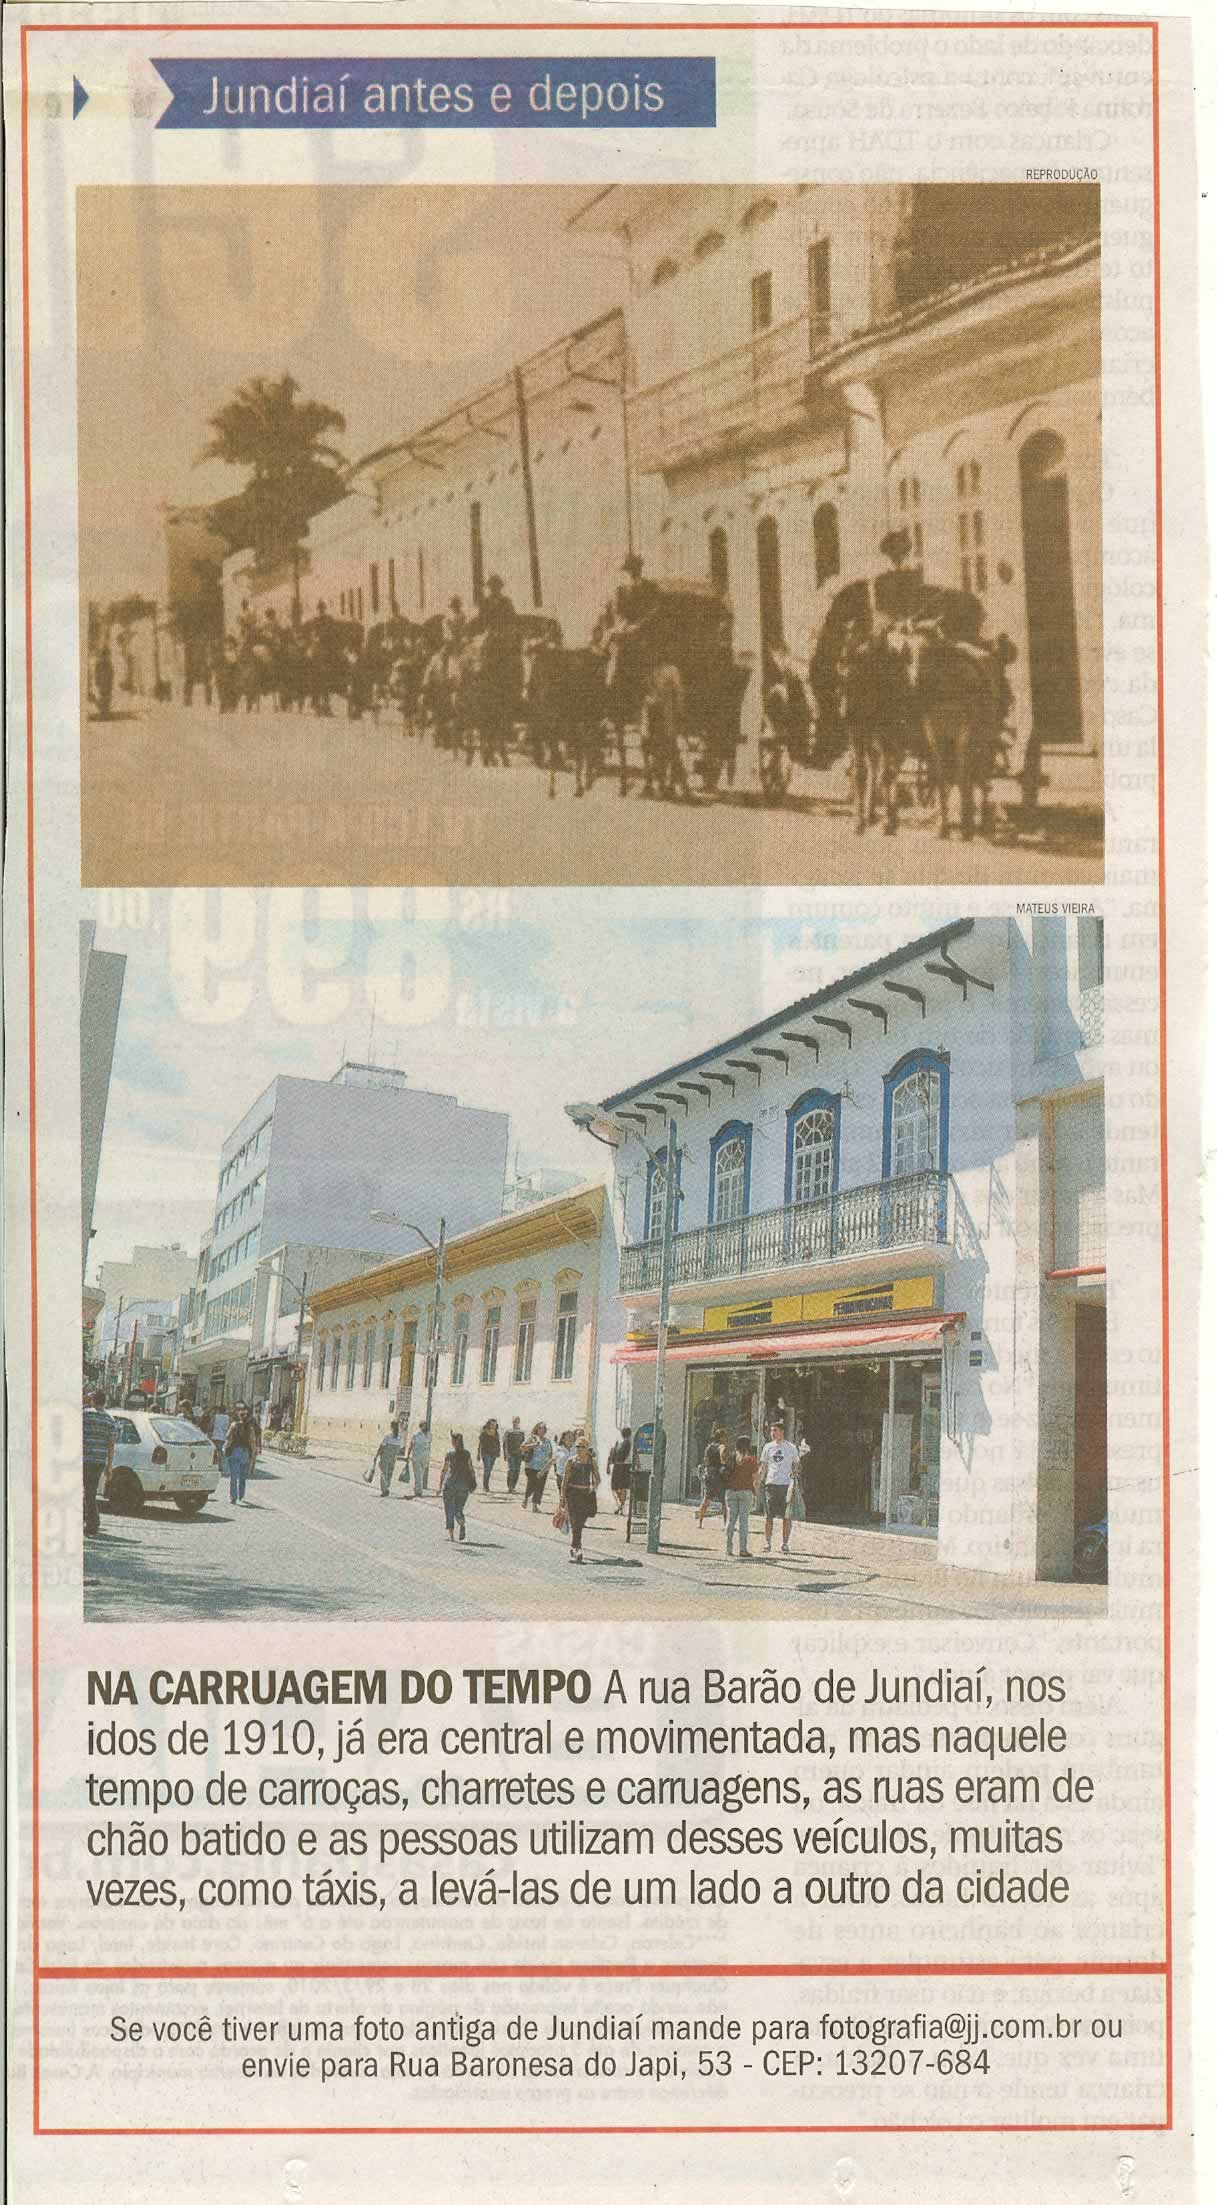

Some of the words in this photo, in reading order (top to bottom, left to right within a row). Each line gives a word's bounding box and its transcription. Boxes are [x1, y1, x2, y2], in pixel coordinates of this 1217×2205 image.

[202, 72, 351, 115] Jundiaí
[363, 77, 474, 113] antes
[490, 83, 512, 113] e
[528, 73, 665, 120] depois
[1026, 167, 1098, 182] REPRODUÇÃO
[1016, 903, 1059, 915] MATEUS
[1061, 903, 1095, 915] VIEIRA
[87, 1670, 139, 1705] NA
[149, 1669, 387, 1705] CARRUAGEM
[401, 1669, 453, 1705] DO
[462, 1669, 592, 1705] TEMPO
[603, 1669, 627, 1704] A
[639, 1677, 690, 1704] rua
[704, 1668, 801, 1704] Barão
[814, 1668, 856, 1704] de
[864, 1665, 992, 1709] Jundiaí,
[1006, 1675, 1066, 1703] nos
[88, 1720, 157, 1756] idos
[167, 1720, 209, 1756] de
[224, 1719, 324, 1761] 1910,
[333, 1717, 365, 1763] já
[377, 1727, 428, 1755] era
[441, 1719, 551, 1755] central
[564, 1727, 584, 1755] e
[597, 1718, 836, 1760] movimentada,
[849, 1726, 921, 1754] mas
[933, 1717, 1067, 1761] naquele
[85, 1773, 194, 1814] tempo
[205, 1770, 247, 1806] de
[259, 1778, 409, 1815] carroças,
[421, 1769, 575, 1806] charretes
[586, 1777, 606, 1805] e
[617, 1774, 810, 1814] carruagens,
[823, 1777, 862, 1804] as
[874, 1776, 944, 1804] ruas
[955, 1775, 1040, 1804] eram
[1052, 1767, 1094, 1803] de
[87, 1820, 169, 1857] chão
[181, 1821, 286, 1856] batido
[298, 1828, 317, 1856] e
[329, 1828, 368, 1856] as
[380, 1828, 518, 1863] pessoas
[530, 1820, 654, 1855] utilizam
[667, 1819, 784, 1855] desses
[793, 1816, 936, 1860] veículos,
[950, 1818, 1063, 1854] muitas
[86, 1879, 186, 1912] vezes,
[198, 1879, 292, 1906] como
[302, 1868, 386, 1912] táxis,
[398, 1878, 418, 1906] a
[432, 1868, 559, 1906] levá-las
[570, 1869, 611, 1905] de
[624, 1877, 676, 1905] um
[690, 1869, 761, 1905] lado
[773, 1877, 792, 1905] a
[805, 1871, 890, 1905] outro
[902, 1869, 944, 1904] da
[956, 1868, 1070, 1904] cidade
[110, 2015, 143, 2042] Se
[152, 2015, 212, 2042] você
[222, 2017, 279, 2042] tiver
[288, 2021, 343, 2042] uma
[354, 2015, 404, 2041] foto
[415, 2015, 495, 2048] antiga
[506, 2015, 538, 2041] de
[547, 2013, 643, 2041] Jundiaí
[652, 2014, 741, 2040] mande
[752, 2020, 809, 2046] para
[819, 2013, 1082, 2046] fotografia@jj.com.br
[1091, 2019, 1122, 2039] ou
[242, 2057, 310, 2078] envie
[321, 2057, 378, 2083] para
[390, 2051, 439, 2077] Rua
[451, 2051, 573, 2077] Baronesa
[584, 2051, 617, 2077] do
[625, 2051, 686, 2082] Japi,
[698, 2050, 732, 2077] 53
[763, 2050, 822, 2076] CEP:
[836, 2049, 991, 2076] 13207-684
